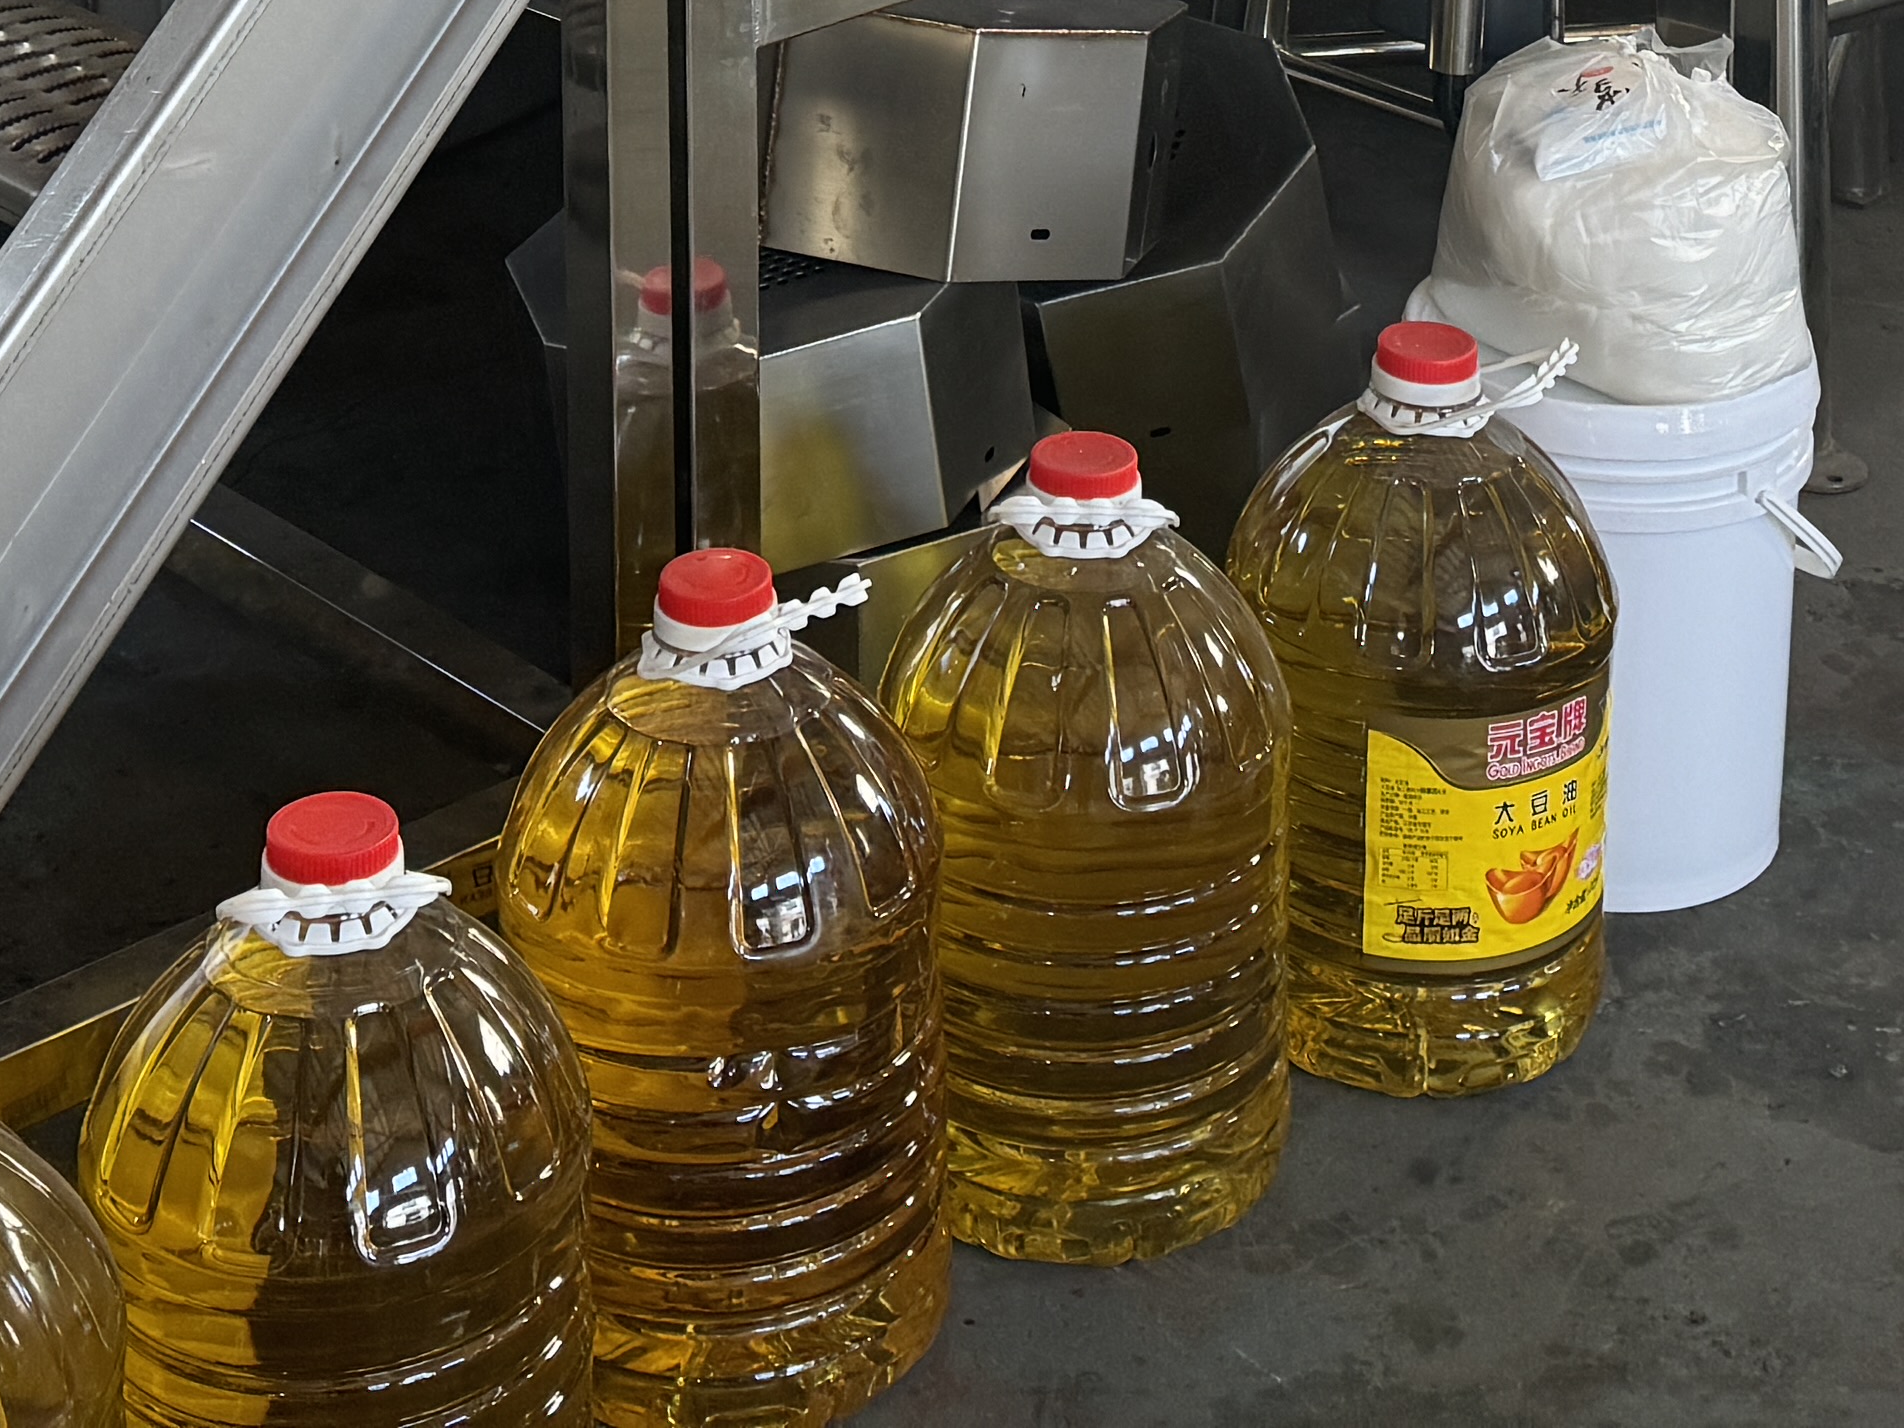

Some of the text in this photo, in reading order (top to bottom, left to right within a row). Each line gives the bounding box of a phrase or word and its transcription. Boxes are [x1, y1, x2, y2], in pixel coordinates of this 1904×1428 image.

[1487, 696, 1587, 763] 元宝牌
[1494, 779, 1578, 826] 大豆油
[1492, 804, 1577, 840] SOYA BEAN OIL
[1397, 906, 1471, 926] 足斤足两
[1403, 925, 1481, 944] 品质如金
